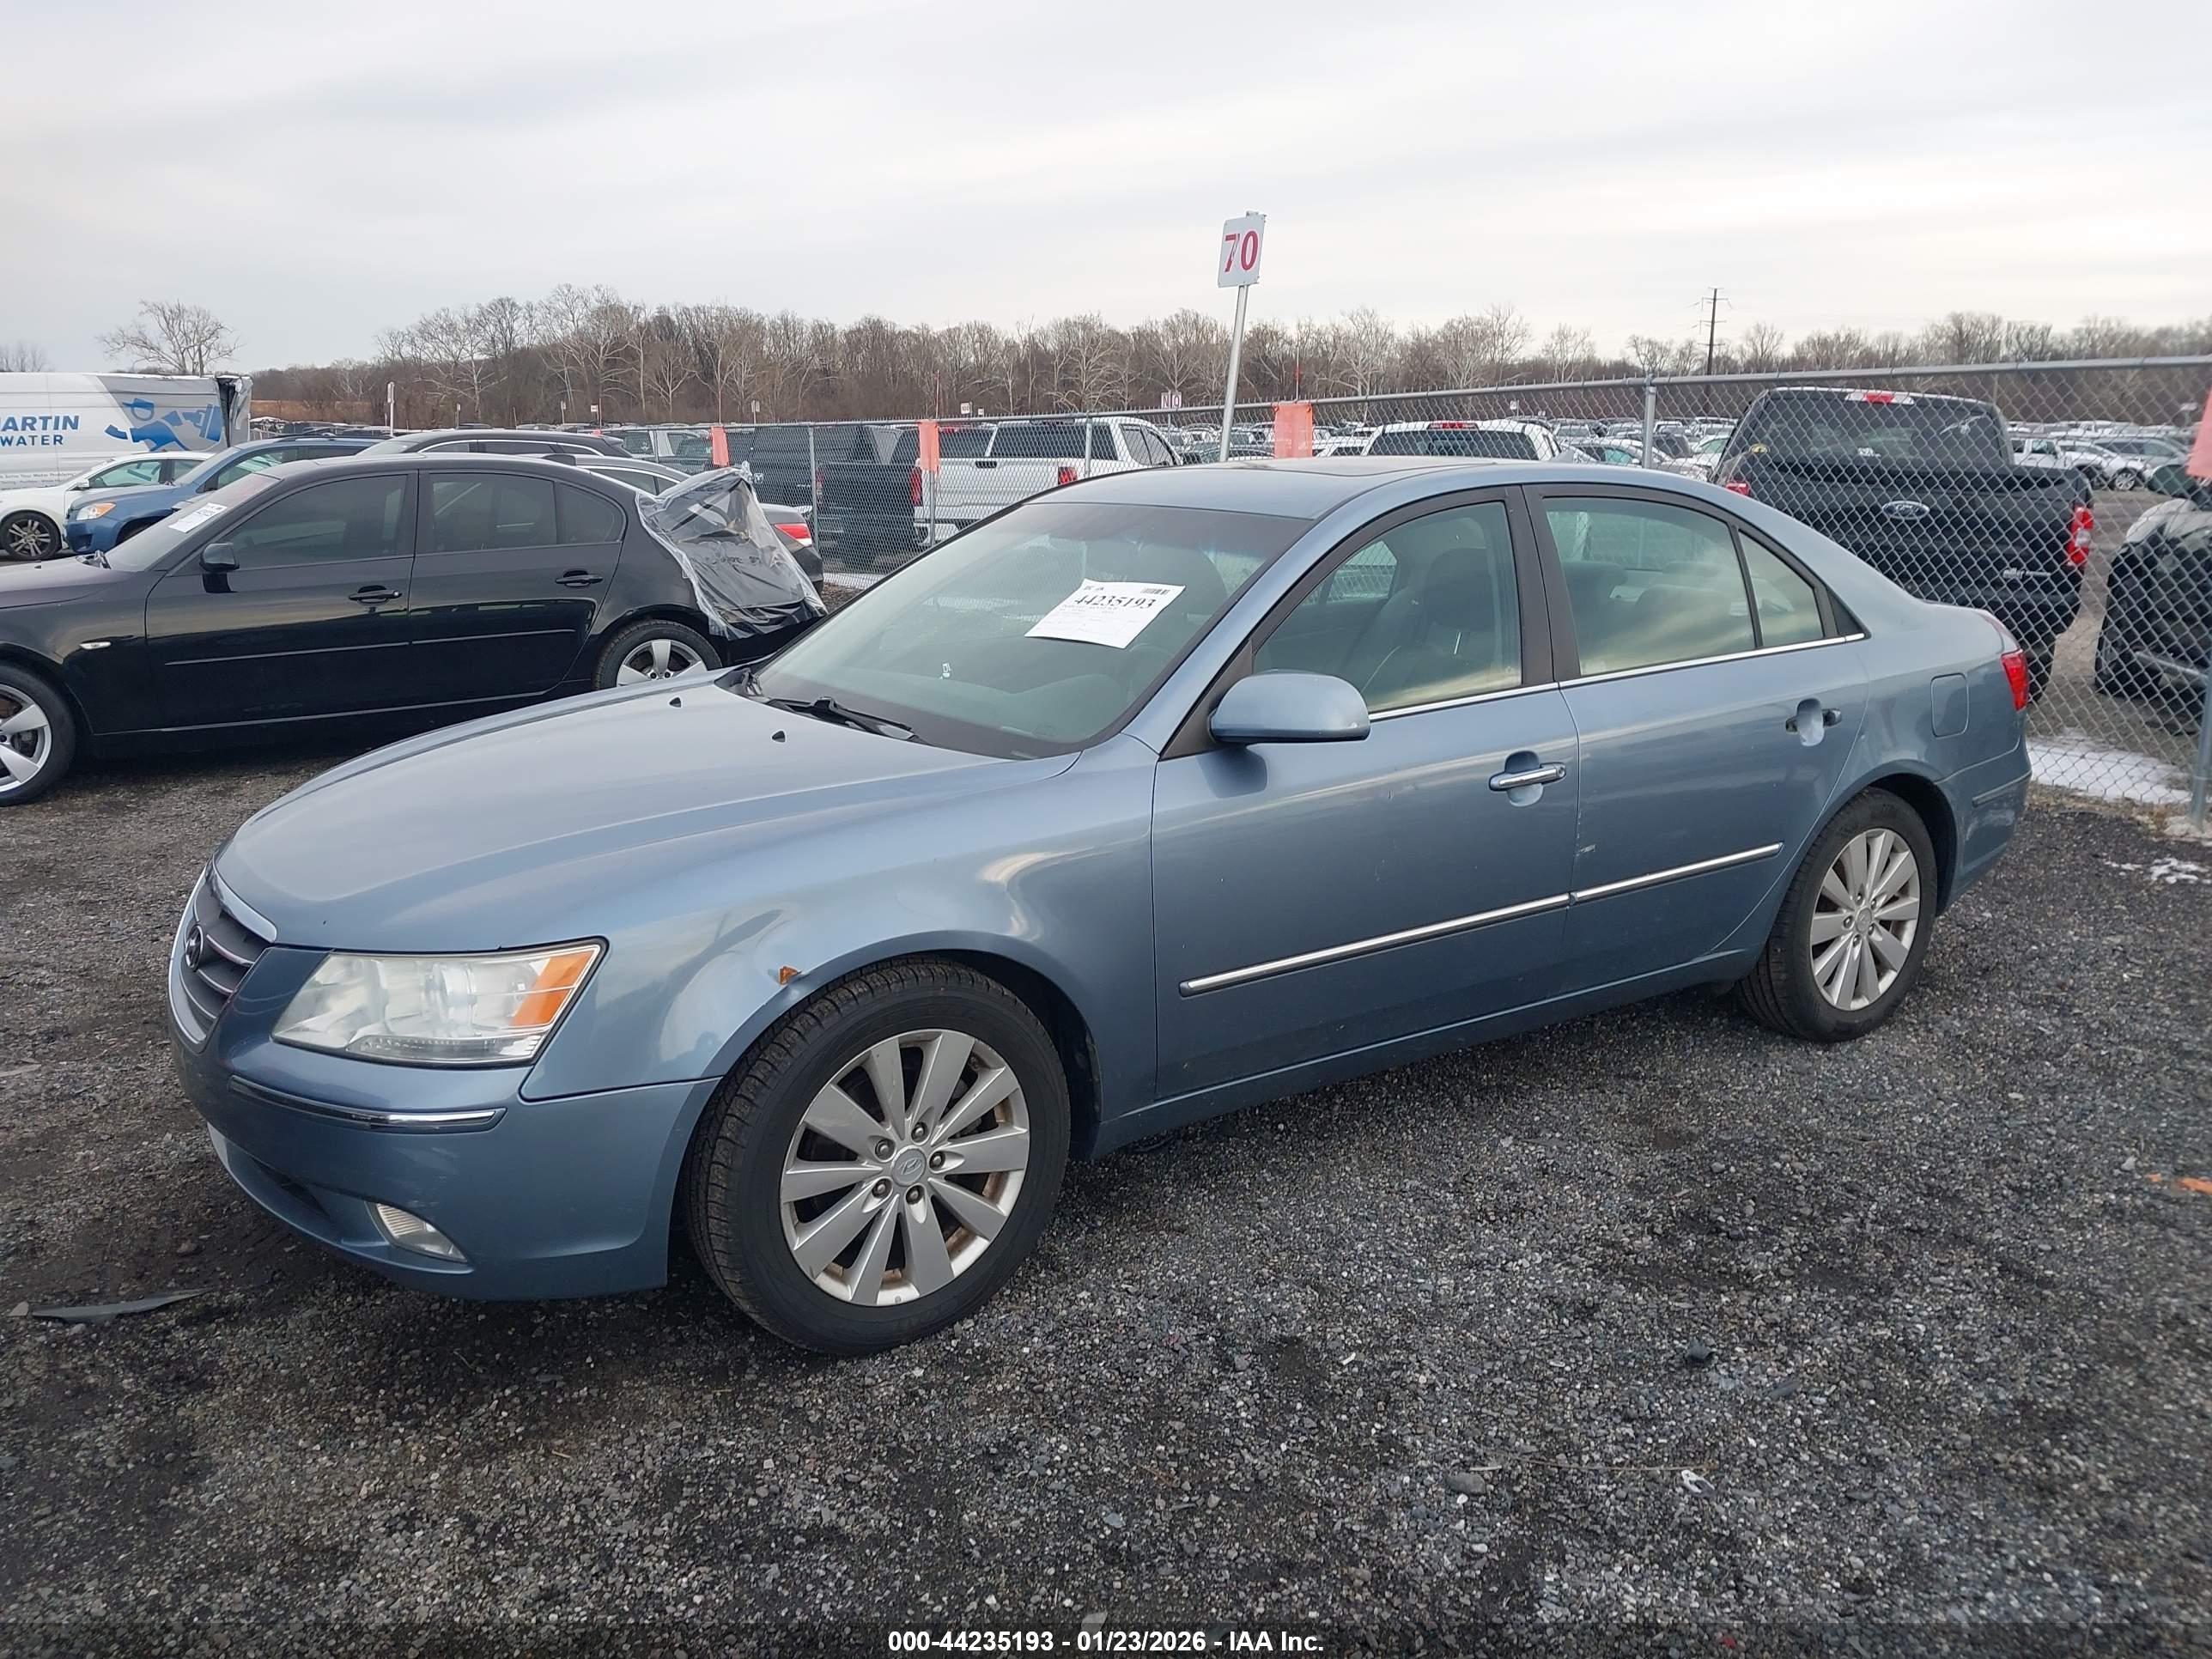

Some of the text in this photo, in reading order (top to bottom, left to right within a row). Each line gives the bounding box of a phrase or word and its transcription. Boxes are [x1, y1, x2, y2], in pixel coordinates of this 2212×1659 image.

[1224, 230, 1259, 272] 70
[0, 416, 79, 431] ARTIN
[0, 434, 64, 447] WATER
[1074, 594, 1157, 610] 44235193
